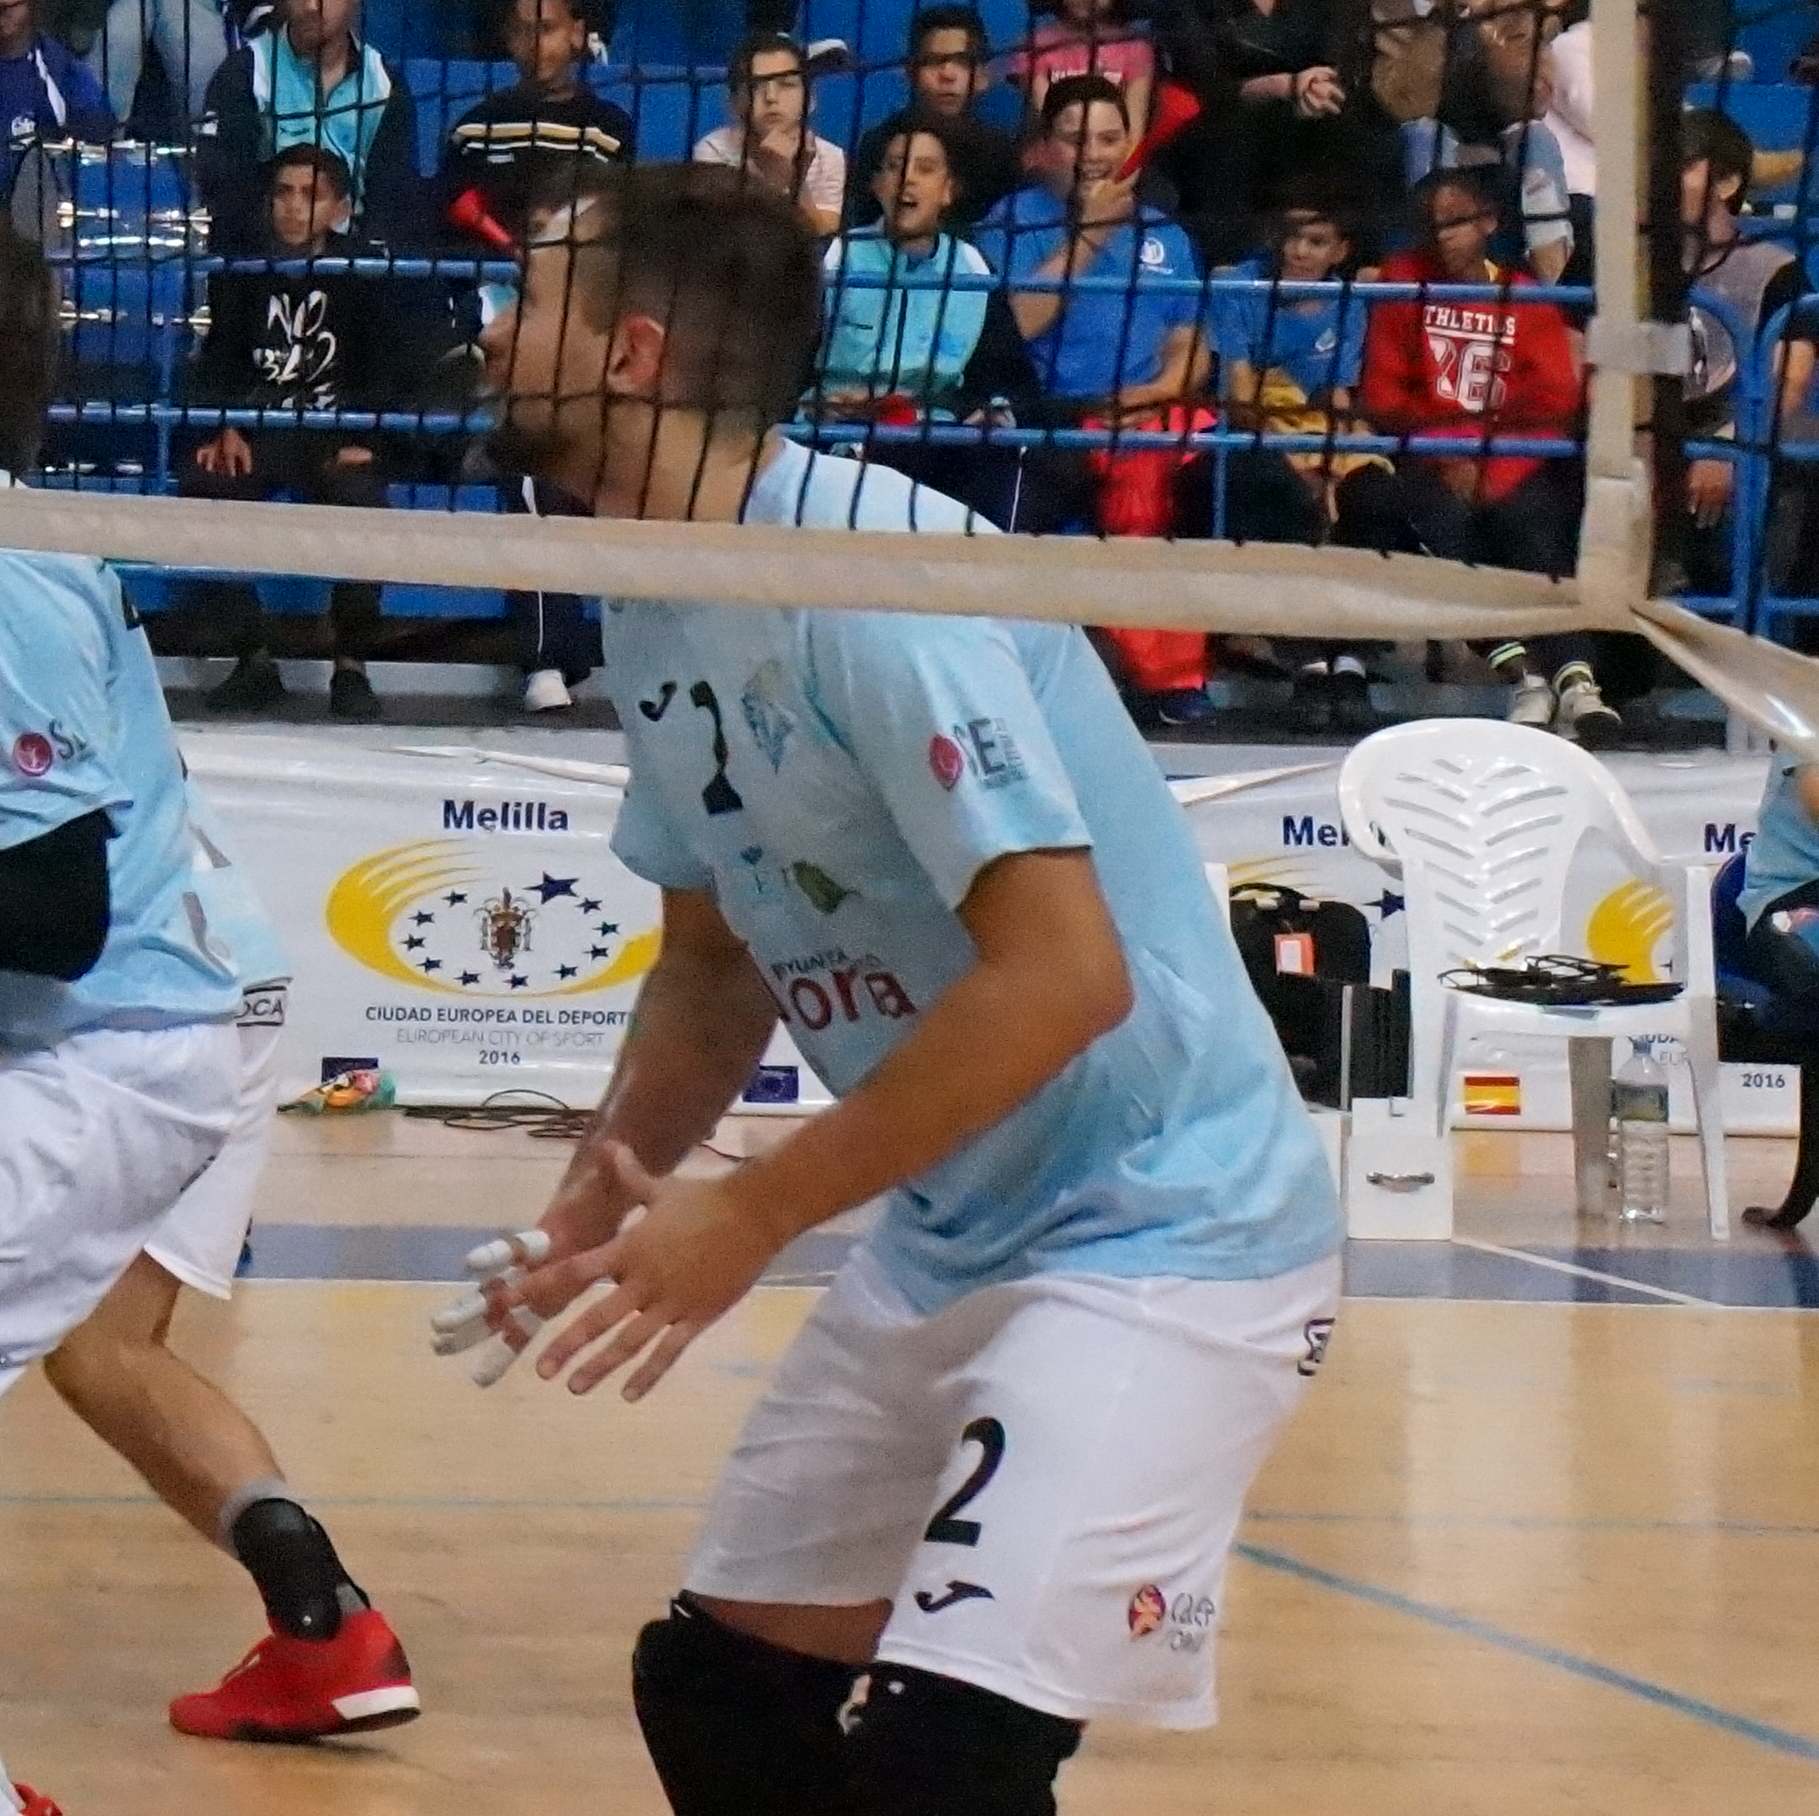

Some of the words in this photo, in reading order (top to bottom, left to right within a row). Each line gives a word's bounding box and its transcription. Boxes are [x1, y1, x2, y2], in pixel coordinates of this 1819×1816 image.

[442, 799, 569, 832] Melilla
[365, 1006, 432, 1023] CIUDAD
[437, 1007, 517, 1024] EUROPEA
[522, 1008, 554, 1025] DEL
[558, 1009, 627, 1026] DEPORT
[396, 1028, 484, 1046] EUROPEAN
[488, 1029, 523, 1047] CITY
[551, 1031, 603, 1048] SPORT
[478, 1050, 521, 1066] 2016
[1741, 1074, 1786, 1089] 2016
[923, 1416, 1005, 1549] 2
